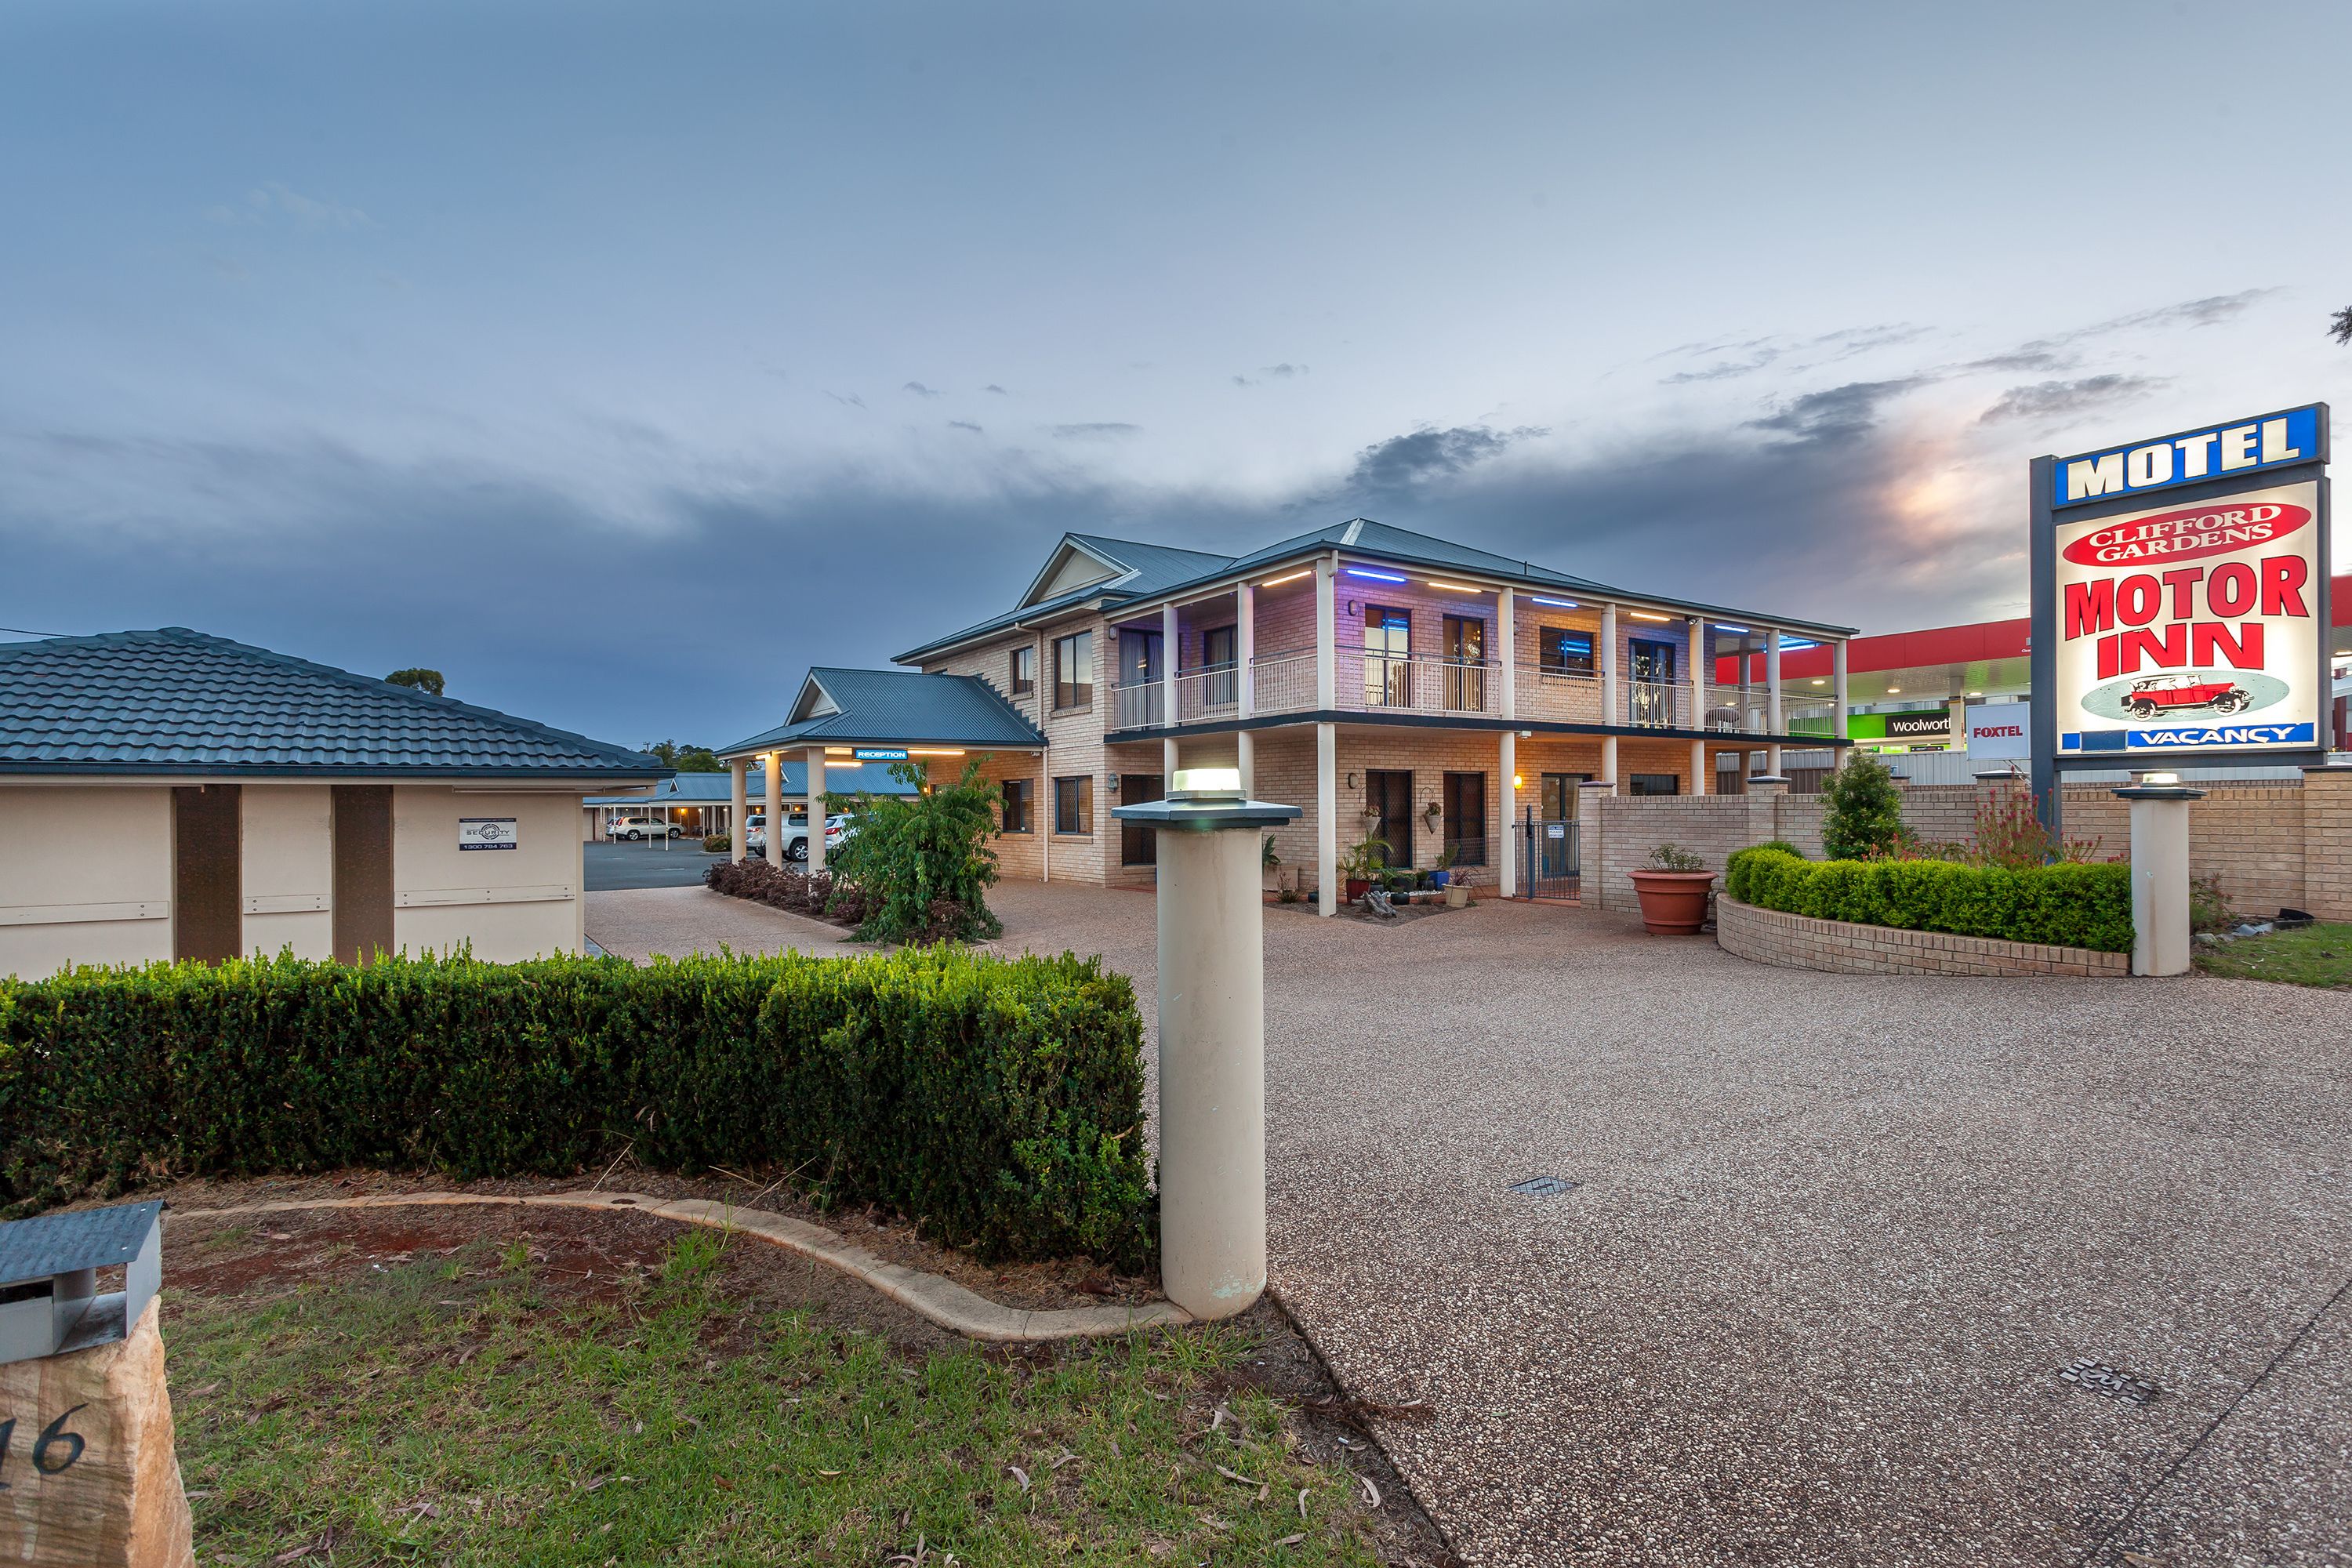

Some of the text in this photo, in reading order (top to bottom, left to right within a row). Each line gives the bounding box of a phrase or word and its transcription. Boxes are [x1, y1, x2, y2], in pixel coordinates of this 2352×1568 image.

[2067, 417, 2300, 501] MOTEL
[2089, 505, 2281, 548] CLIFFORD
[2096, 522, 2274, 562] GARDENS
[2064, 554, 2310, 641] MOTOR
[2097, 622, 2264, 680] INN
[1973, 725, 2023, 738] FOXTEL
[2140, 726, 2295, 744] VACANCY
